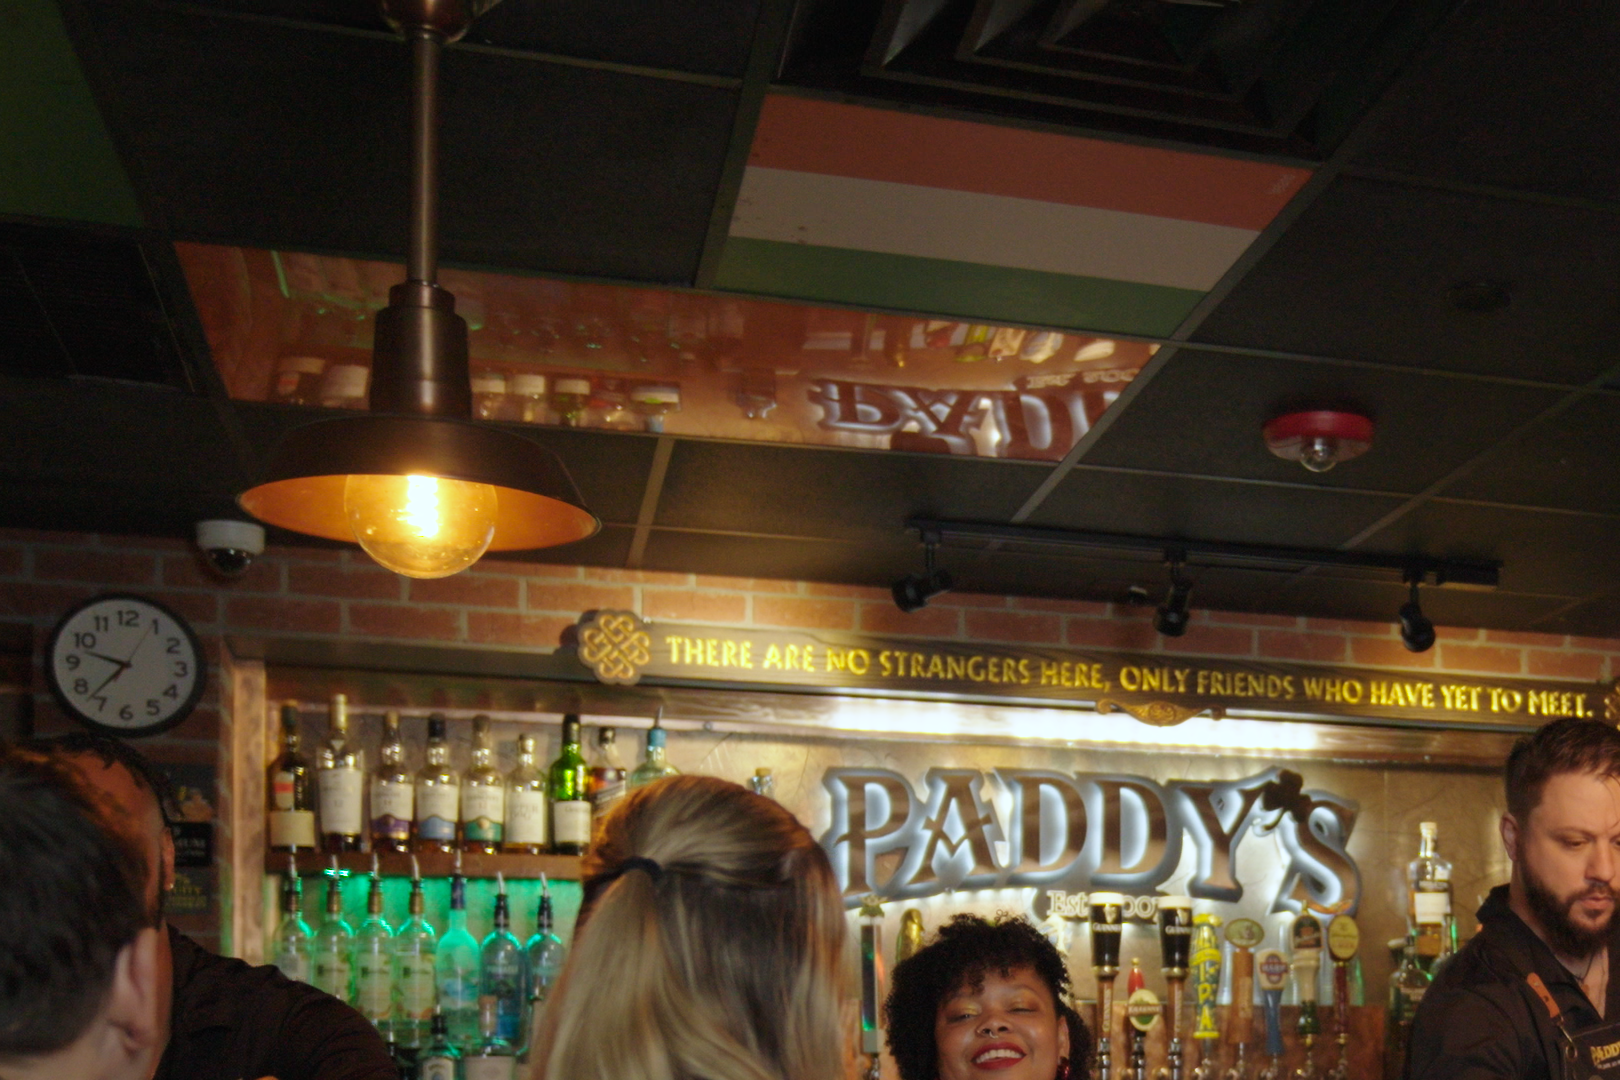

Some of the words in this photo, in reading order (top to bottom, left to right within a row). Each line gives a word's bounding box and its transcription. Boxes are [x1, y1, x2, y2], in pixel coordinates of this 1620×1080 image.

[94, 616, 109, 632] 11
[117, 610, 140, 627] 12
[74, 632, 96, 649] 10
[166, 637, 181, 654] 2
[65, 654, 81, 671] 9
[174, 661, 188, 678] 3
[73, 678, 89, 695] 8
[666, 636, 754, 670] THERE
[763, 643, 816, 674] ARE
[826, 648, 871, 676] NO
[880, 651, 1031, 685] STRANGERS
[1041, 661, 1111, 692] HERE,
[1119, 666, 1191, 695] ONLY
[1197, 670, 1296, 701] FRIENDS
[1304, 678, 1364, 705] WHO
[1371, 681, 1437, 709] HAVE
[1440, 686, 1482, 712] YET
[1487, 688, 1523, 714] TO
[1528, 691, 1595, 720] MEET.
[162, 684, 178, 699] 4
[93, 696, 108, 712] 7
[119, 704, 134, 721] 6
[146, 699, 161, 716] 5
